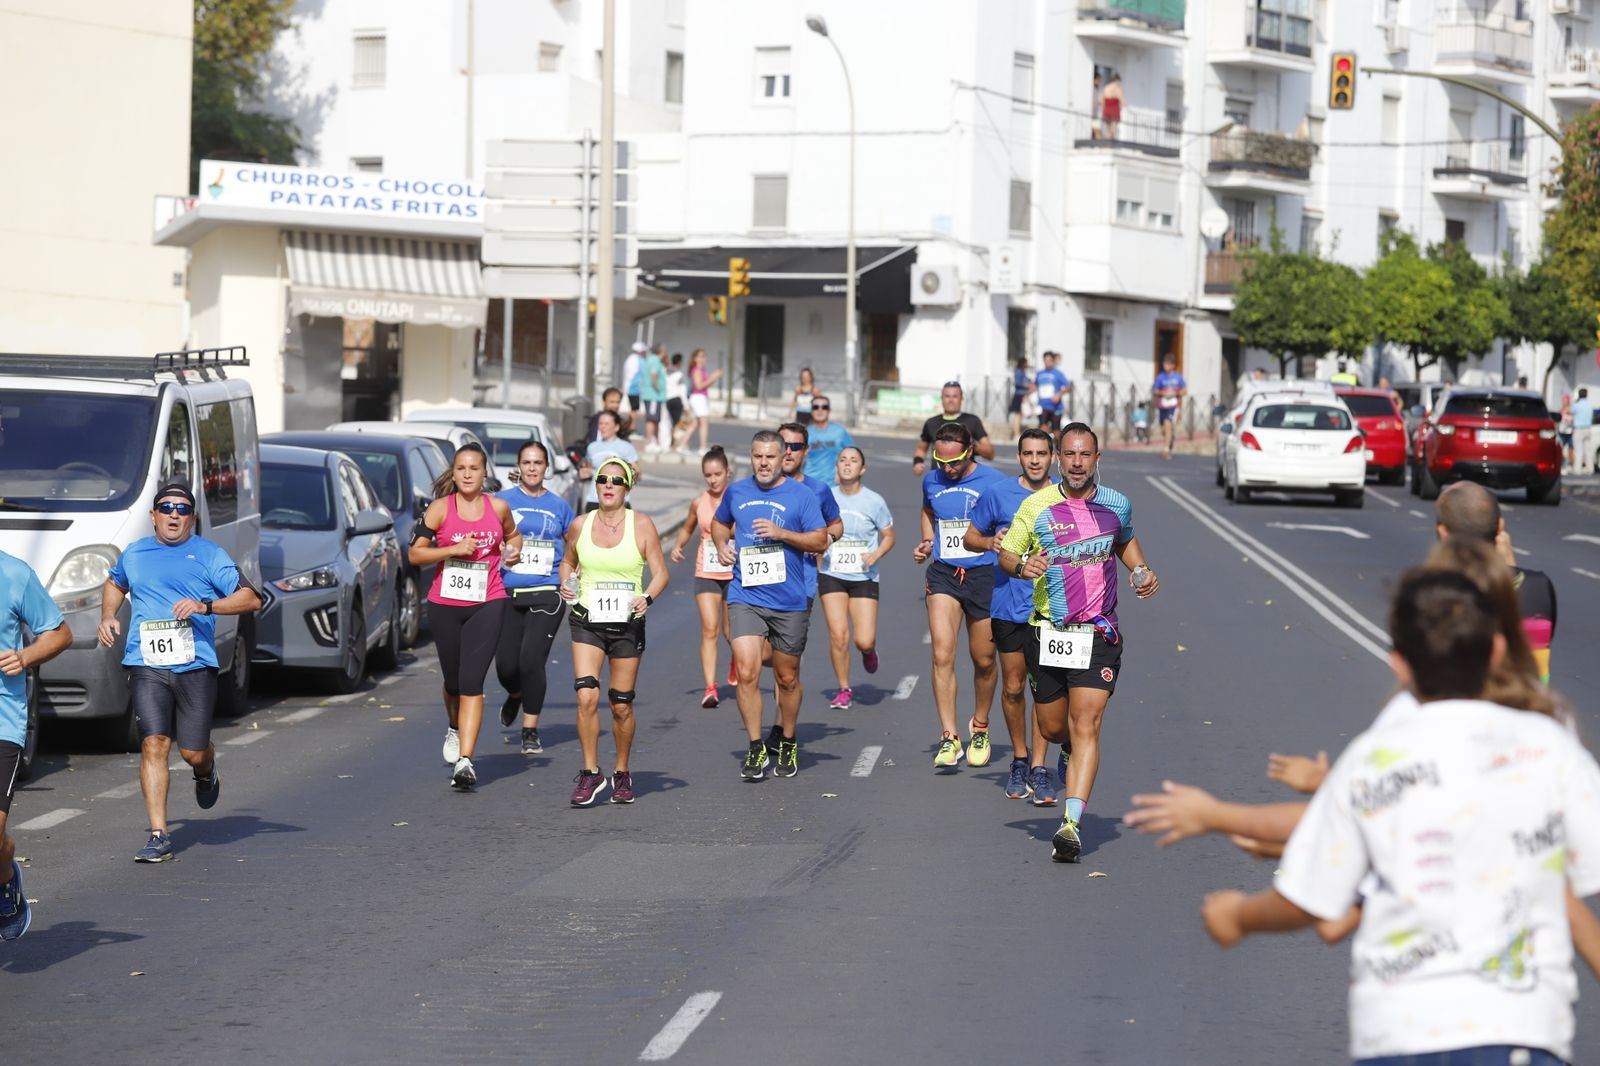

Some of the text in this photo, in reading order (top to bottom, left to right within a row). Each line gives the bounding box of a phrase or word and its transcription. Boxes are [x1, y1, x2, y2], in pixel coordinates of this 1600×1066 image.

[236, 169, 354, 190] CHURROS
[270, 190, 478, 217] PATATAS FRITAS
[946, 535, 964, 548] 20
[838, 553, 857, 564] 220
[748, 561, 769, 575] 373
[449, 574, 472, 589] 384
[597, 597, 619, 611] 111
[149, 637, 173, 654] 161
[1048, 639, 1073, 655] 683
